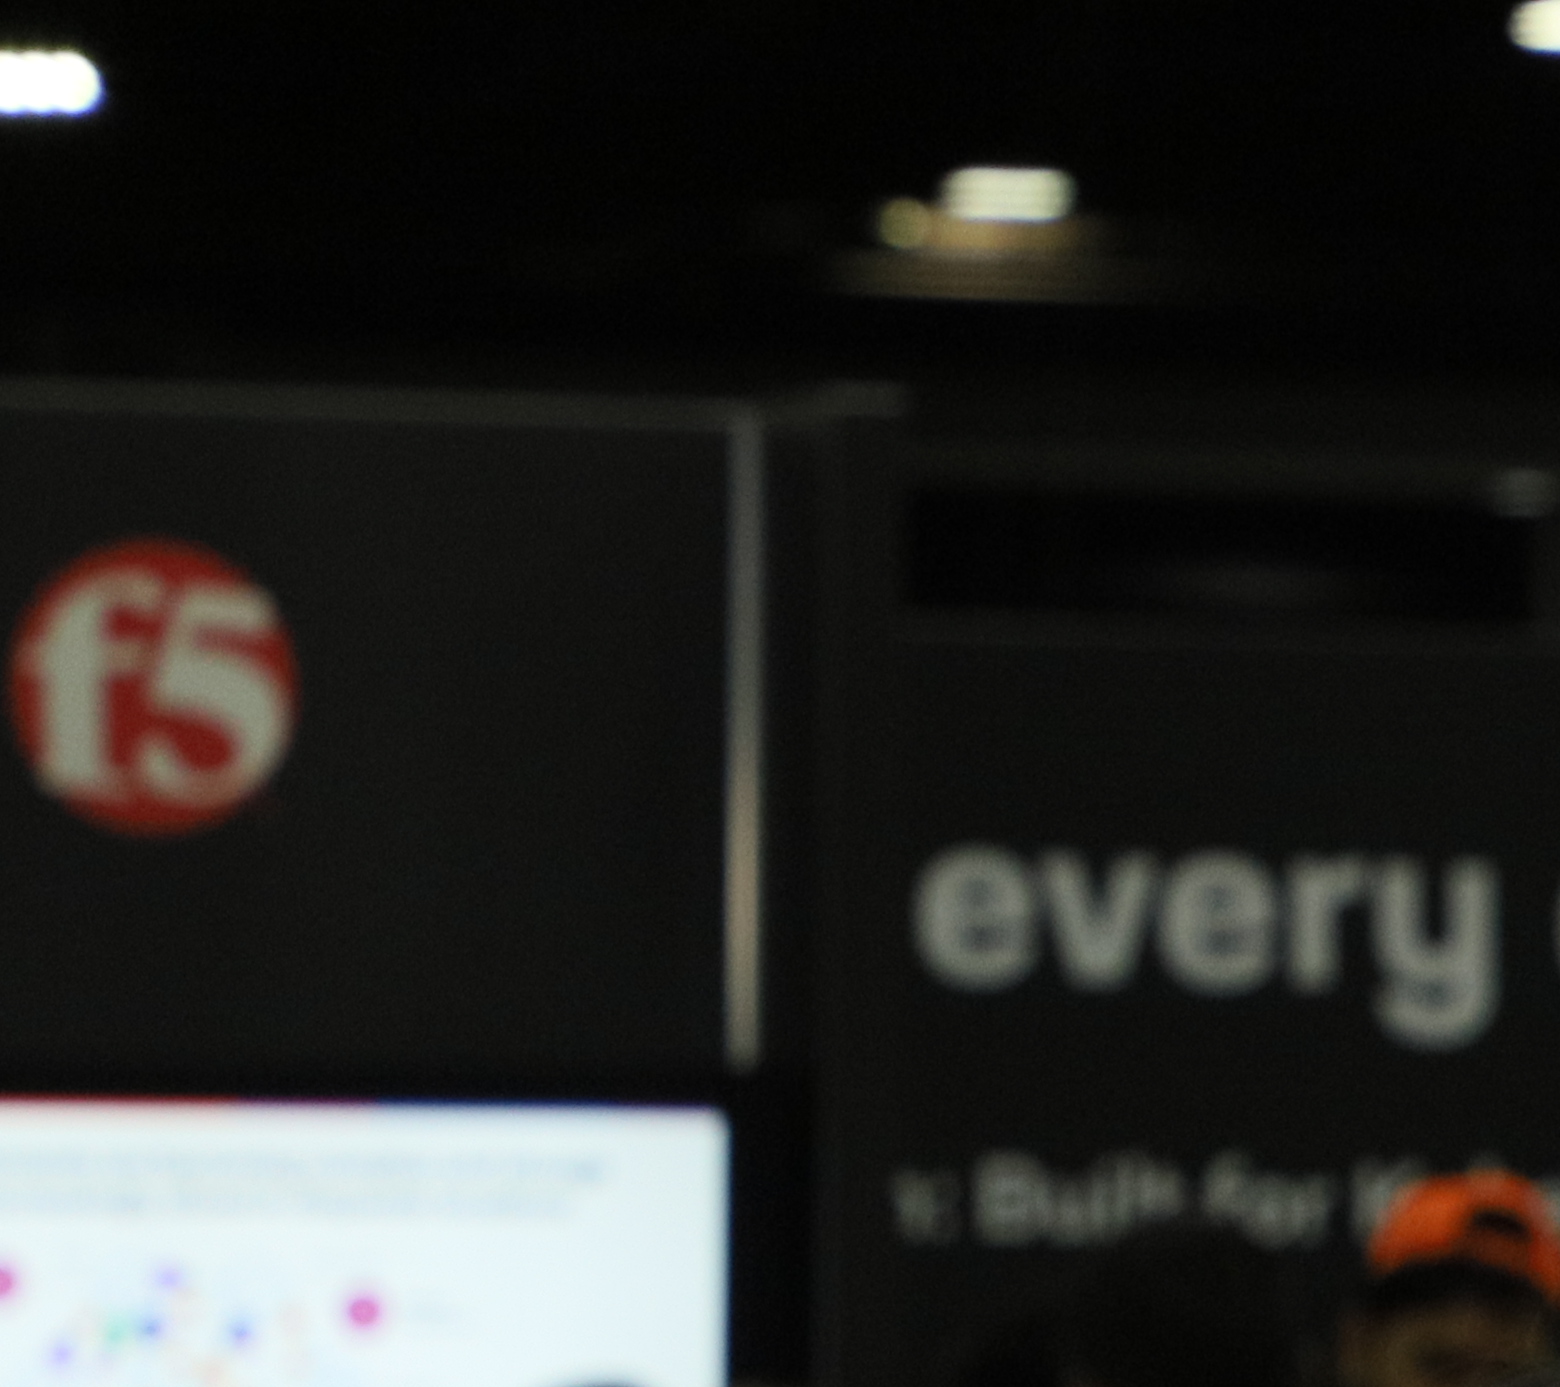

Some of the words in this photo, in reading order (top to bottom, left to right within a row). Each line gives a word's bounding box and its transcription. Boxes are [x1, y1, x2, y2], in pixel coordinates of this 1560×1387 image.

[34, 566, 292, 806] f5
[912, 843, 1502, 1052] every
[1203, 1150, 1338, 1248] for
